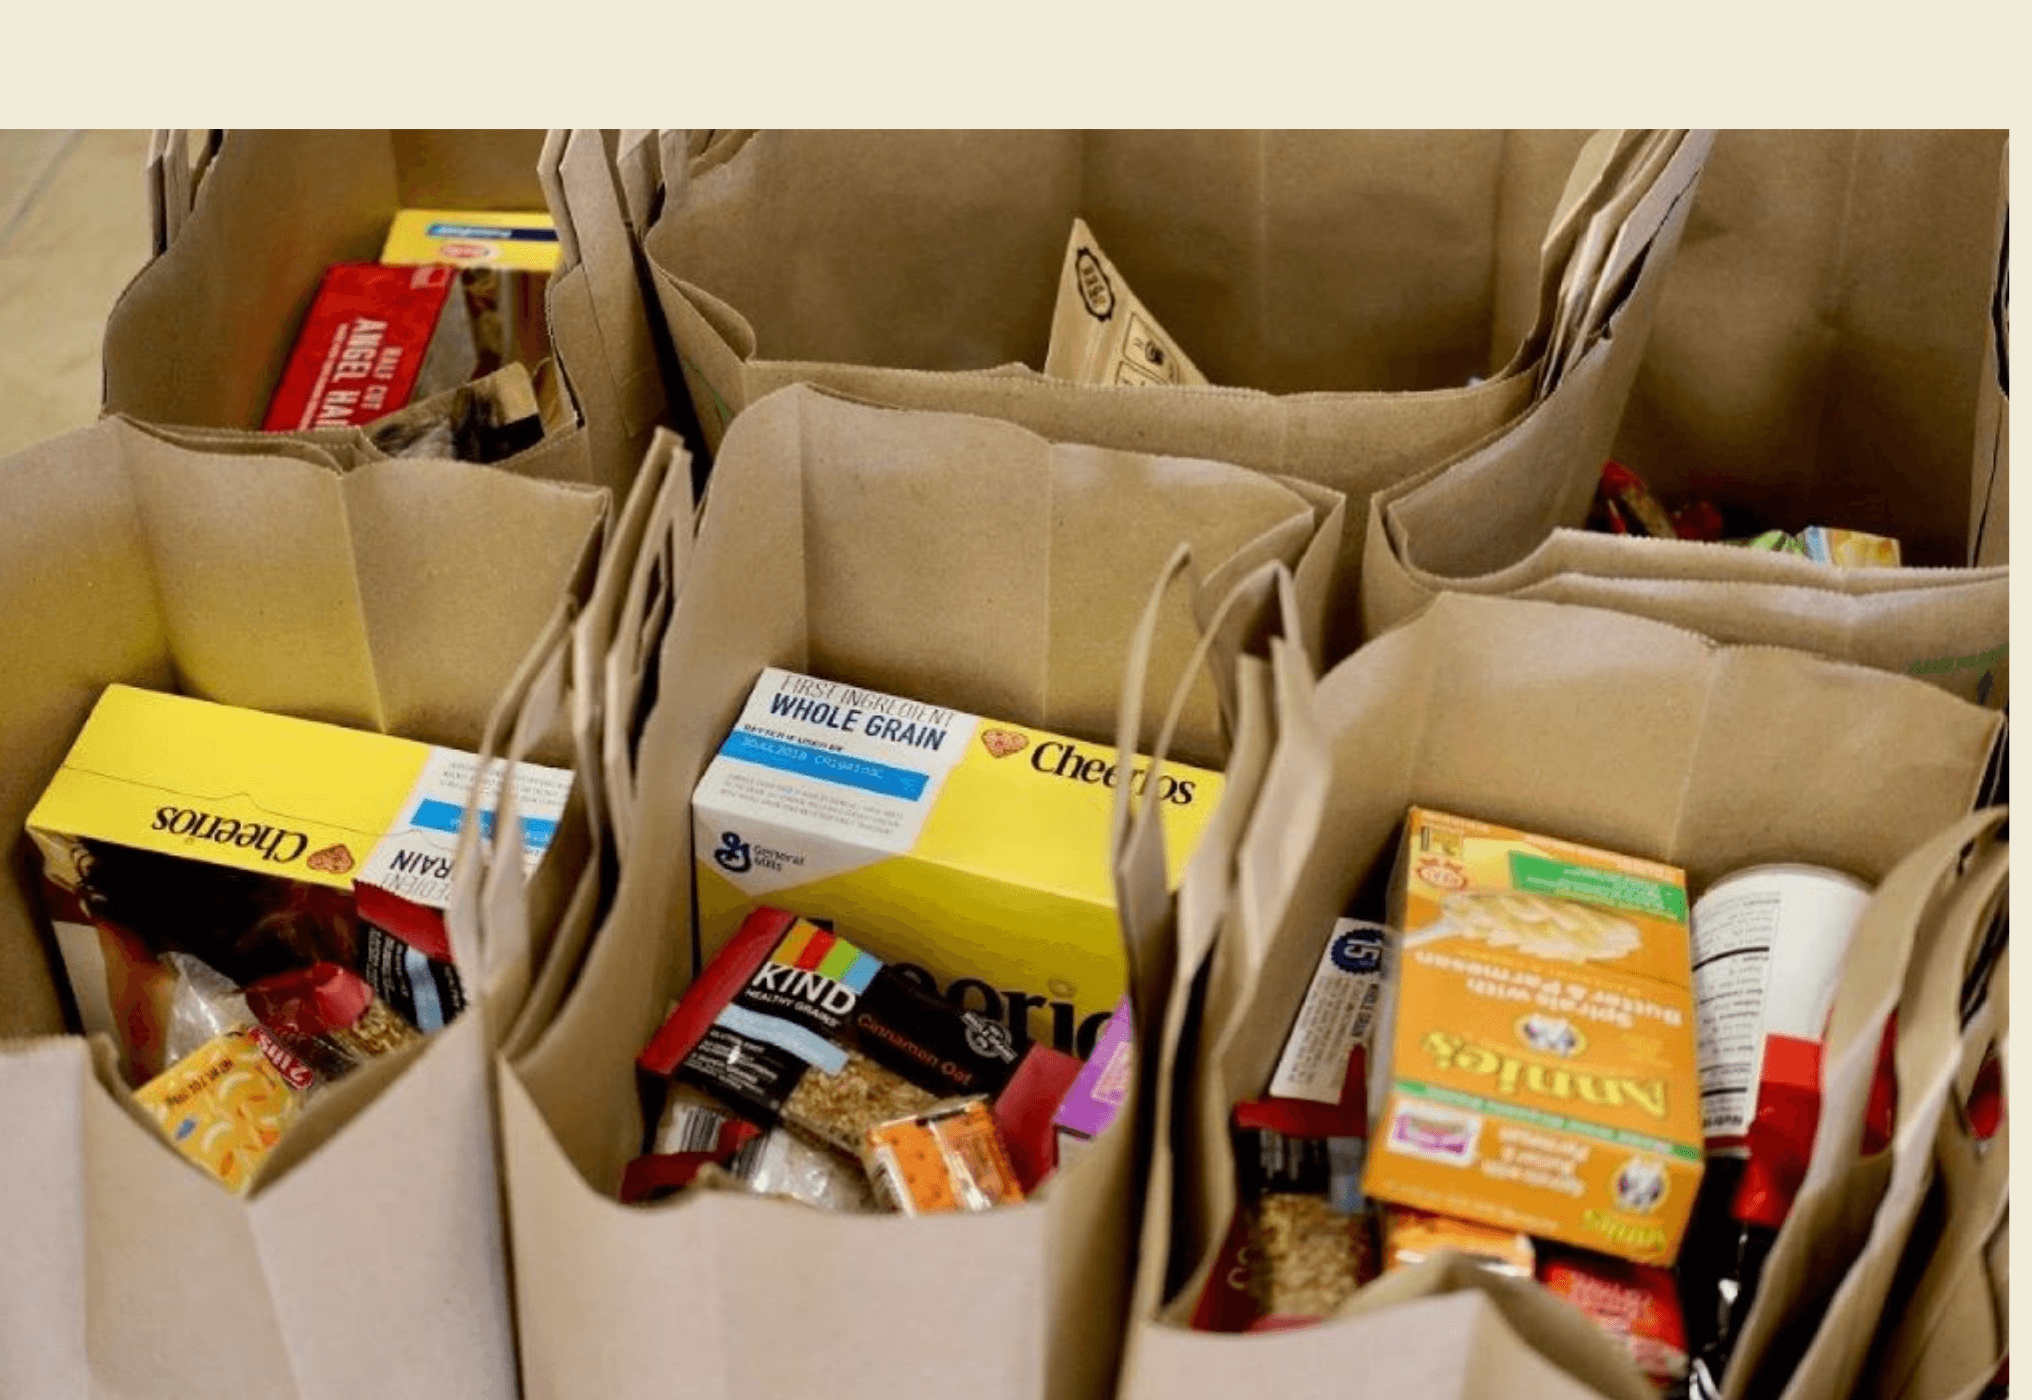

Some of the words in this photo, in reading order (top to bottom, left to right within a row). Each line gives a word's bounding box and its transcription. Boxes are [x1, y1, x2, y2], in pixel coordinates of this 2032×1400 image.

[331, 317, 388, 383] ANGEL
[315, 390, 361, 427] HAI
[770, 693, 863, 733] WHOLE
[864, 714, 947, 751] GRAIN
[779, 675, 836, 700] FIRST
[840, 688, 954, 730] INGREDIENT
[151, 805, 309, 866] Cheerios
[753, 845, 804, 866] General
[390, 848, 454, 880] RAIN
[744, 988, 793, 1007] HEALTHY
[752, 961, 856, 1014] KIND
[1592, 990, 1683, 1027] Butter
[858, 1012, 939, 1068] Cinnamon
[1423, 1030, 1666, 1117] Annie's
